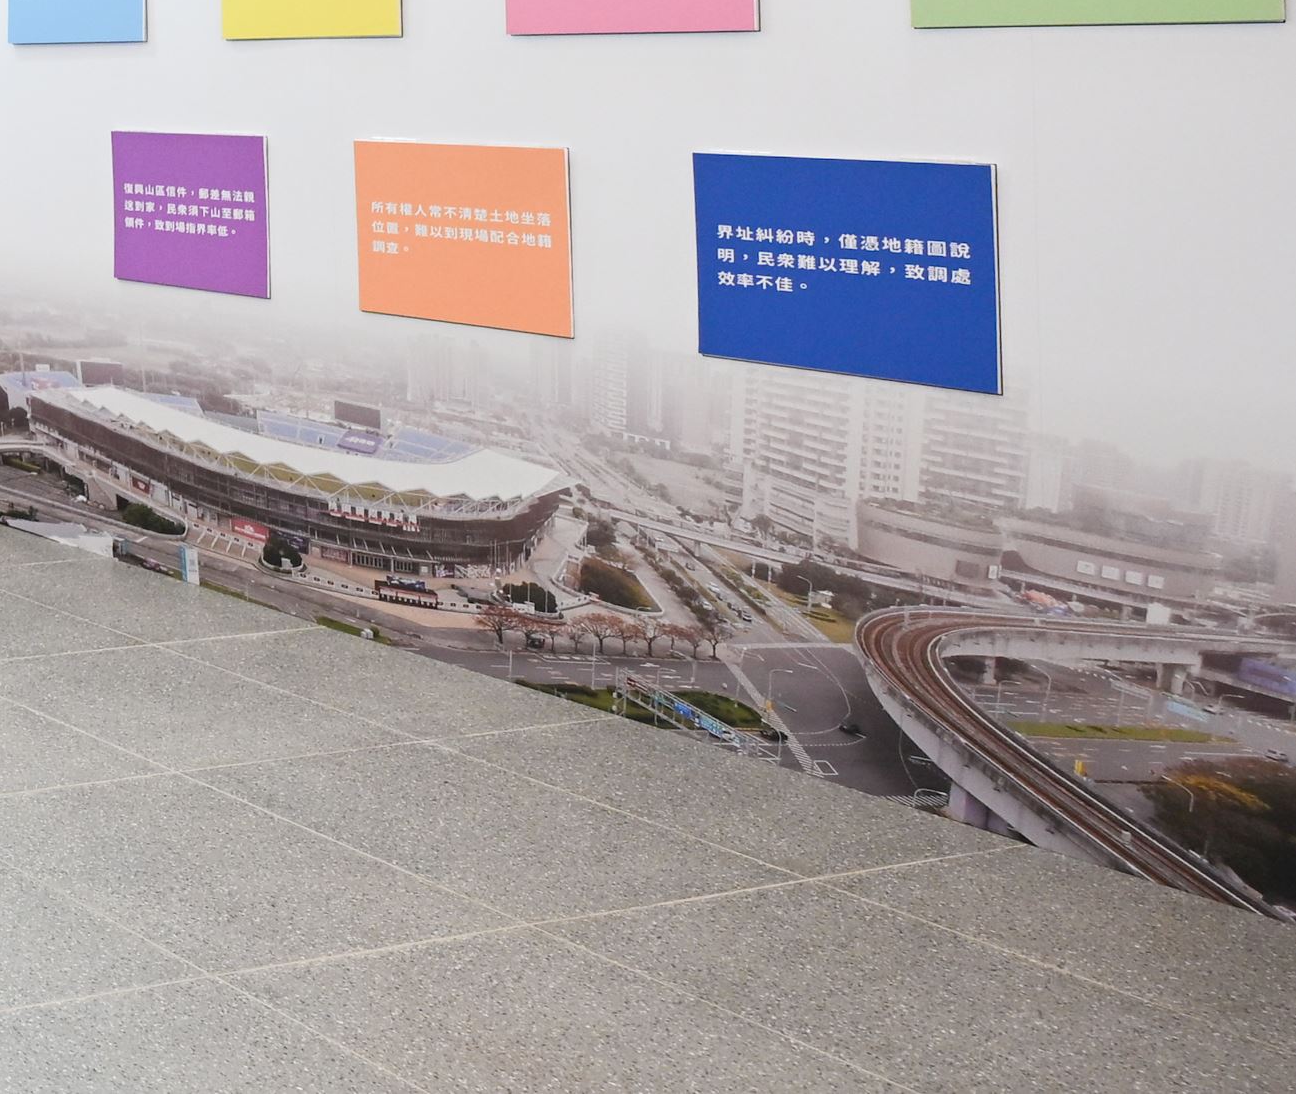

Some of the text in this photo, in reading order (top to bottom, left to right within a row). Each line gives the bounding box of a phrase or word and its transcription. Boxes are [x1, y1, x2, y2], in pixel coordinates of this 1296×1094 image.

[123, 183, 255, 203] 復興山區信件，郵差無法親
[124, 200, 256, 222] 送到家，民眾須下山至郵箱
[371, 201, 551, 227] 所有權人常不清楚土地坐落
[125, 217, 237, 237] 領件，致到場指界率低。
[372, 221, 552, 248] 位置，難以到現場配合地籍
[372, 240, 410, 254] 調查。
[717, 224, 971, 259] 界址糾紛時，僅憑地籍圖說
[717, 248, 972, 285] 明，民眾難以理解，致調處
[718, 271, 808, 292] 效率不佳。
